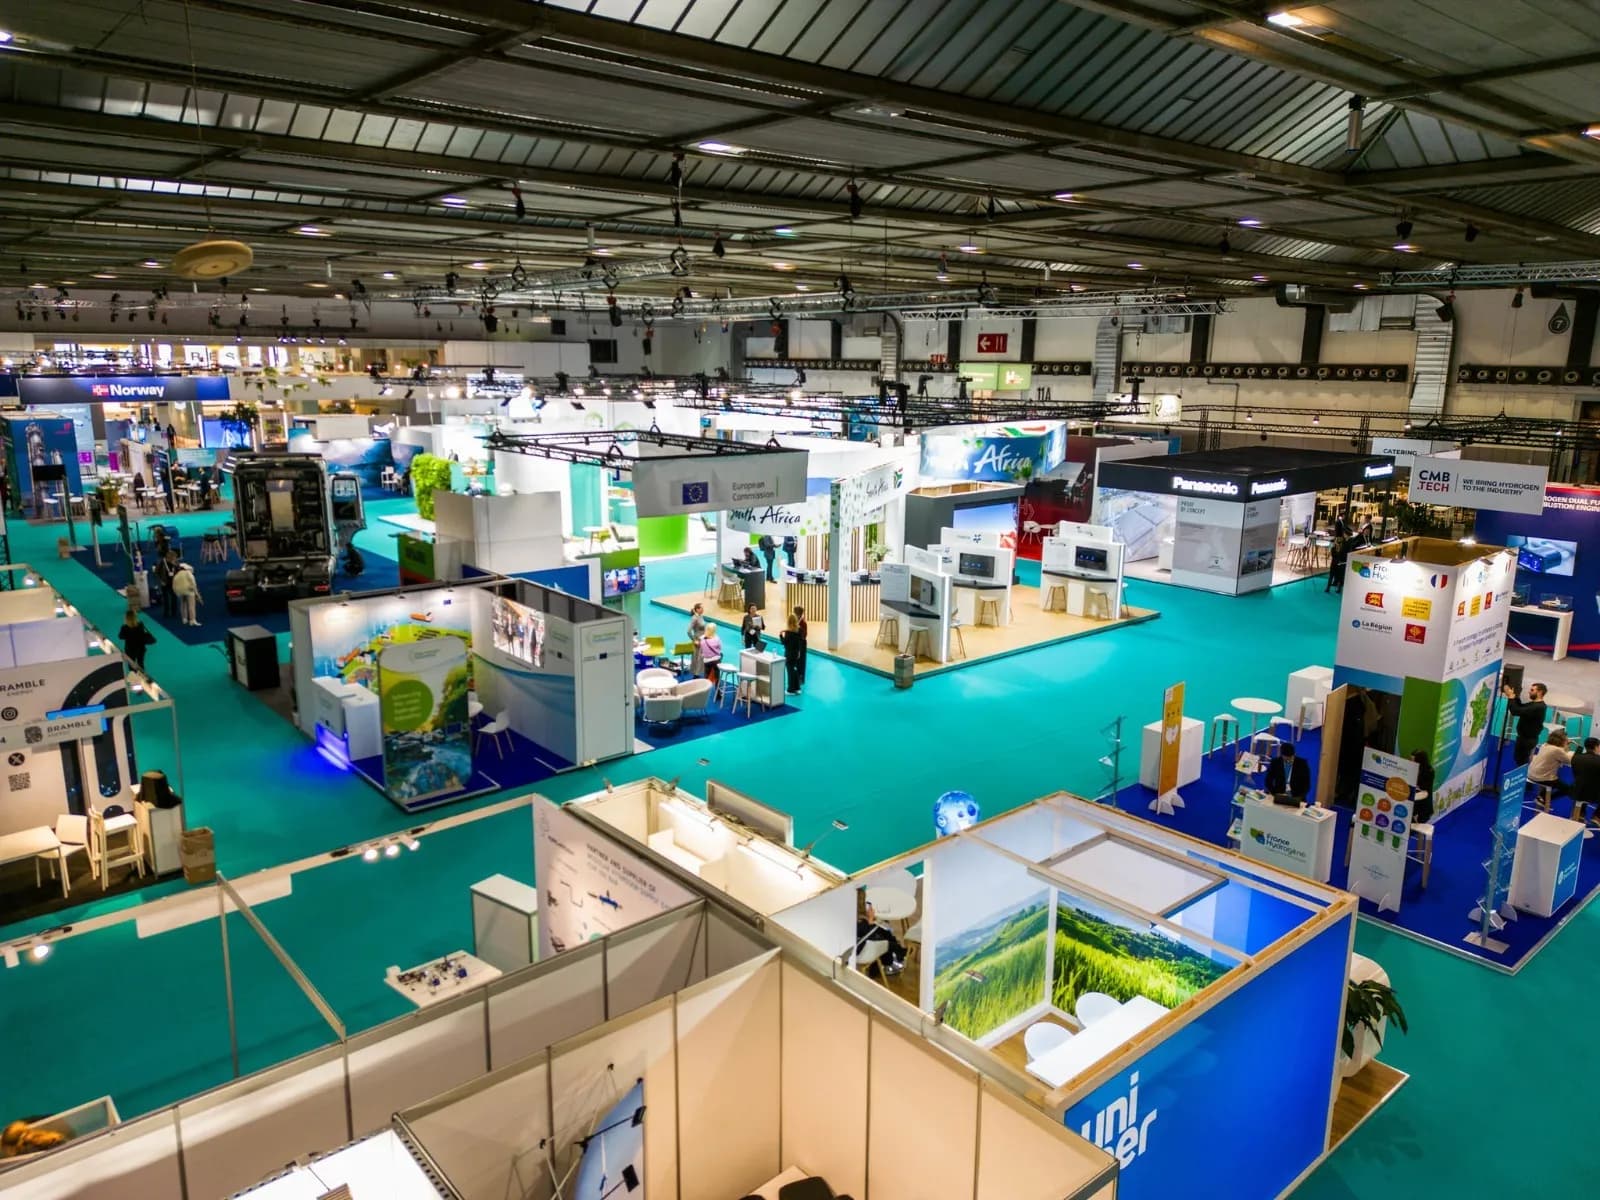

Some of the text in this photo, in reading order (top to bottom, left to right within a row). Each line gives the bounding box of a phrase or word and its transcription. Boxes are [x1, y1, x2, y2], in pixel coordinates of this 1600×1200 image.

[109, 384, 164, 397] Norway
[1383, 448, 1418, 456] CATERING
[974, 443, 1033, 474] Africa
[1419, 470, 1450, 482] CMB
[732, 481, 765, 491] European
[1172, 475, 1239, 495] Panasonic
[1475, 479, 1498, 488] BRING
[1498, 481, 1540, 491] HYDROGEN
[732, 491, 775, 501] Commission
[1486, 487, 1524, 496] INDUSTRY
[760, 504, 801, 524] Africa
[47, 720, 93, 733] BRAMBLE
[1266, 833, 1290, 846] France
